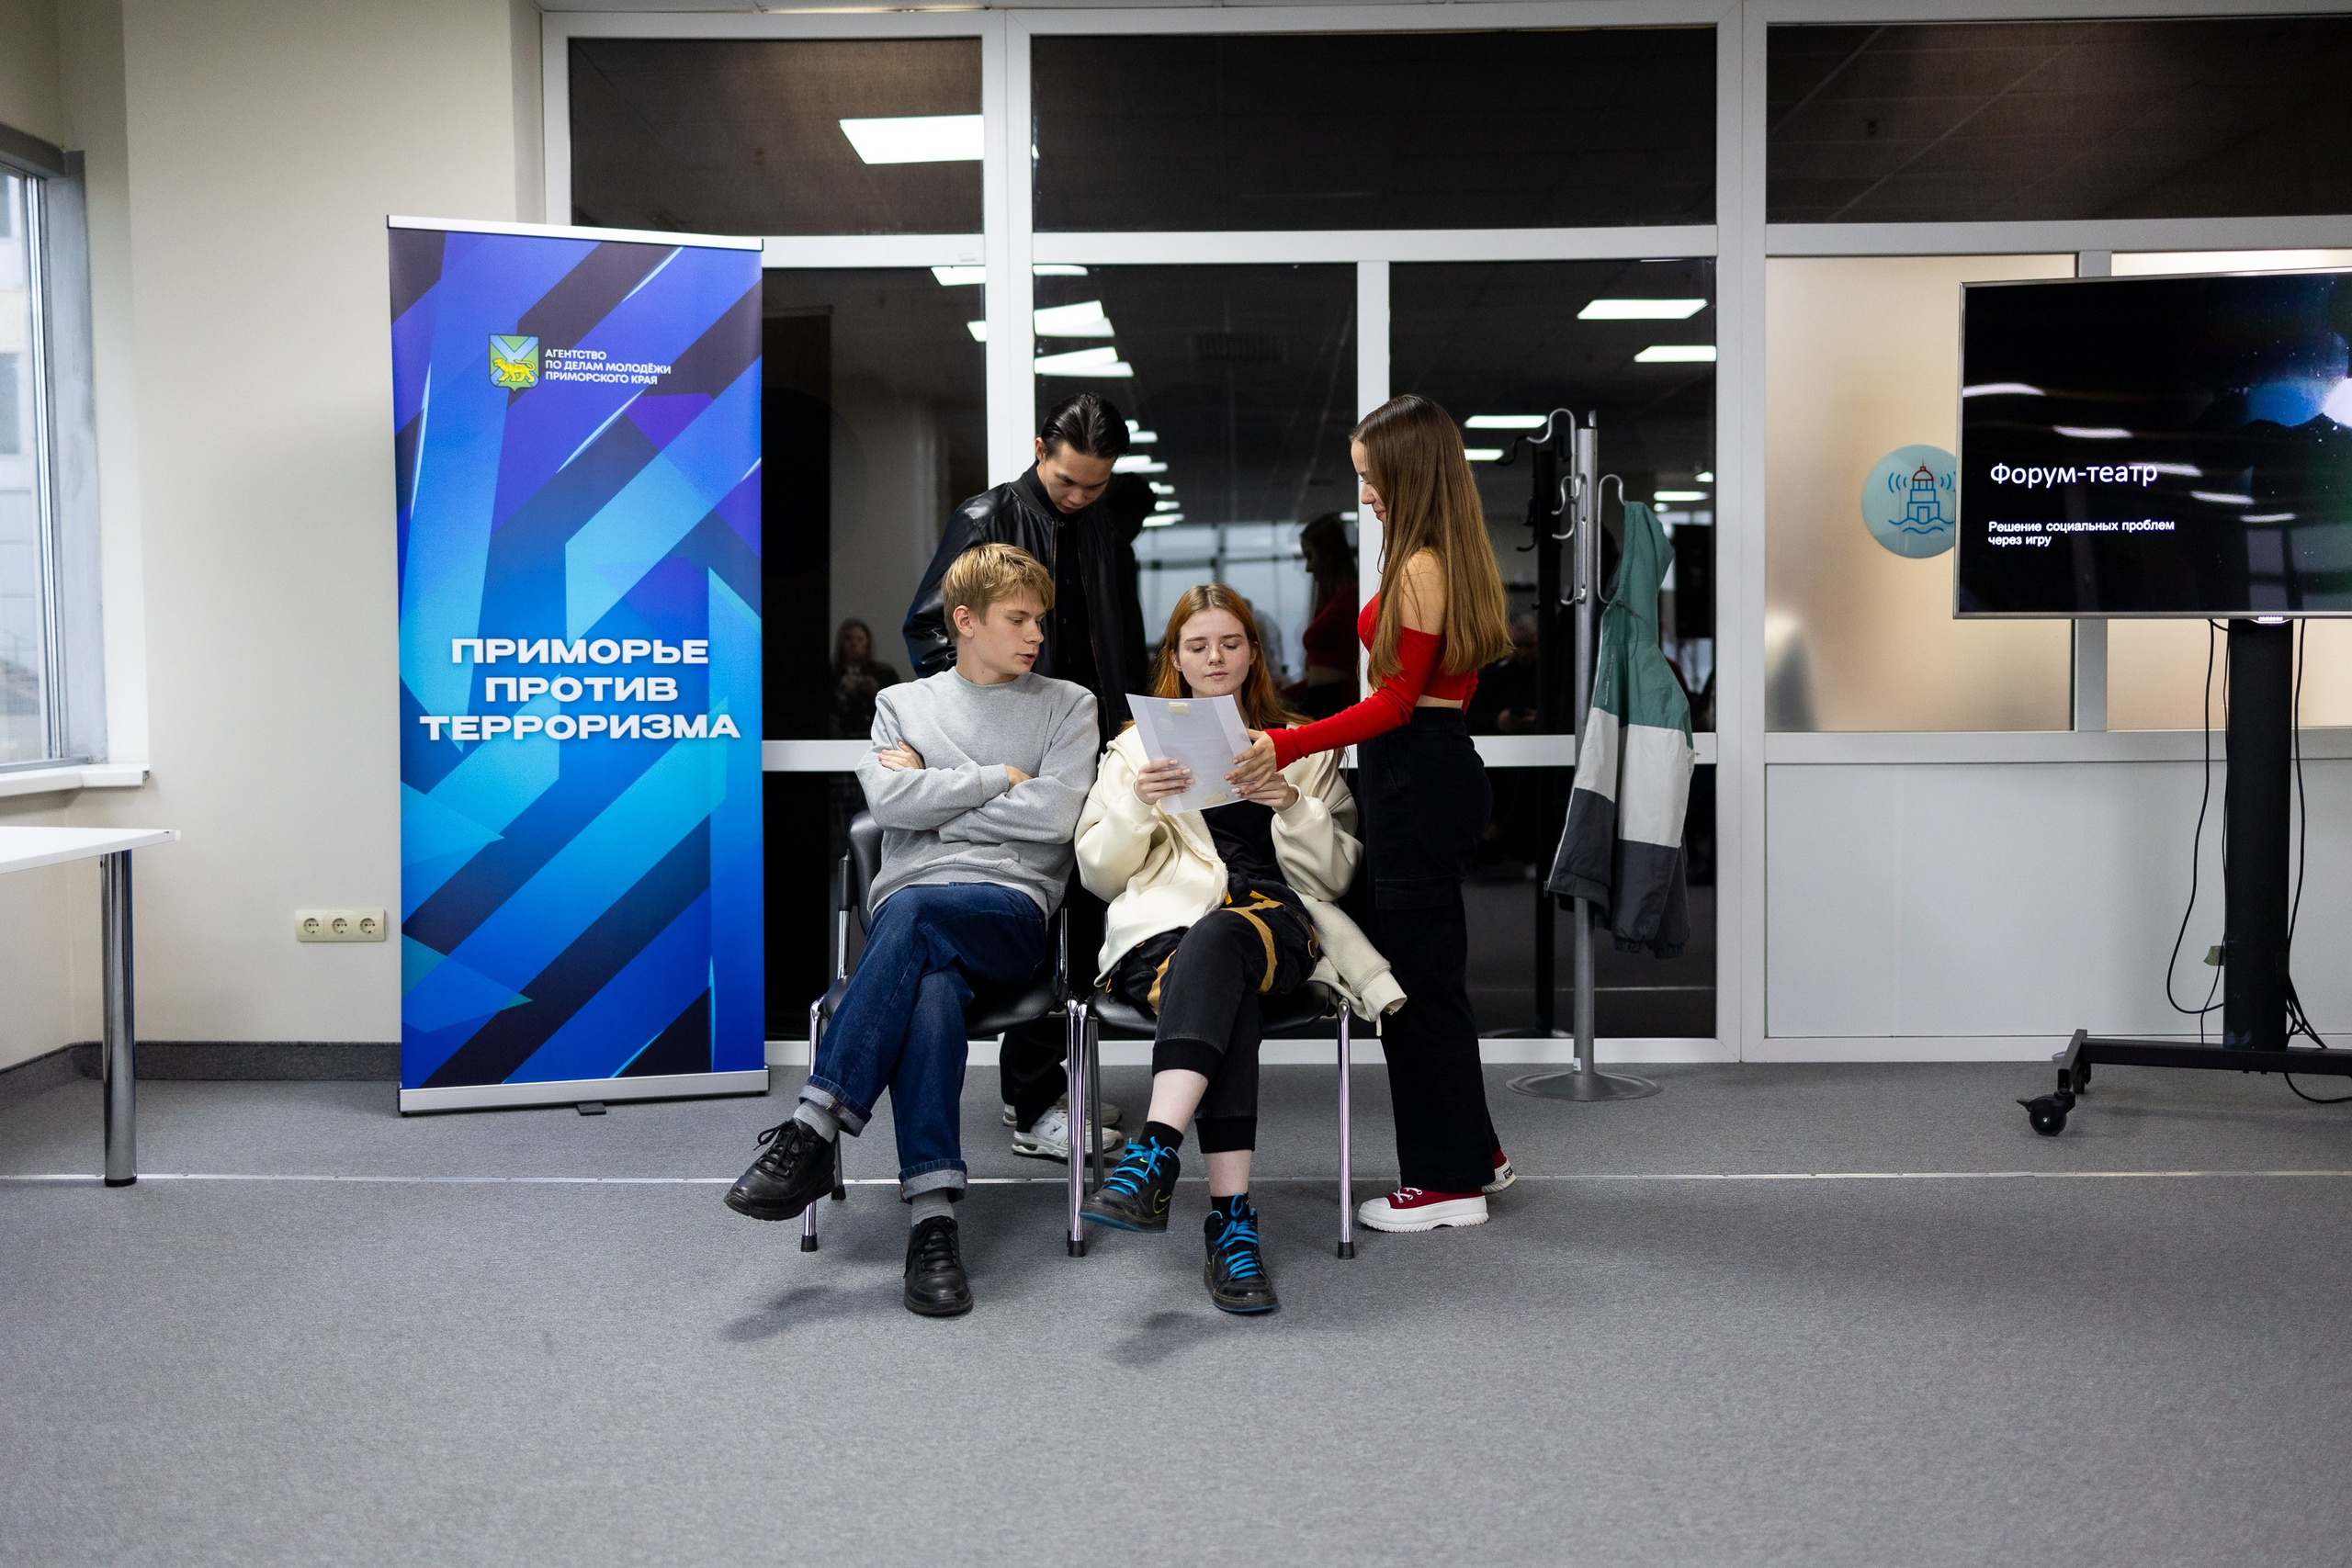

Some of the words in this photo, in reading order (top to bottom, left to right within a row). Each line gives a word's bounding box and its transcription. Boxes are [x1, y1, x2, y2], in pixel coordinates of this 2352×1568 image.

[545, 348, 607, 361] АГЕНТСТВО
[545, 359, 562, 369] ПО
[563, 360, 604, 372] ДЕЛАМ
[605, 362, 672, 375] МОЛОДЁЖИ
[545, 370, 629, 384] ПРИМОРСКОГО
[630, 374, 658, 385] КРАЯ
[1990, 462, 2158, 489] Форум-театр
[1988, 521, 2042, 532] Решение
[2045, 521, 2119, 534] социальных
[2121, 519, 2175, 533] проблем
[1987, 536, 2023, 547] через
[2025, 536, 2052, 547] игру
[452, 638, 708, 664] ПРИМОРЬЕ
[485, 676, 678, 702] ПРОТИВ
[419, 714, 741, 740] ТЕРРОРИЗМА
